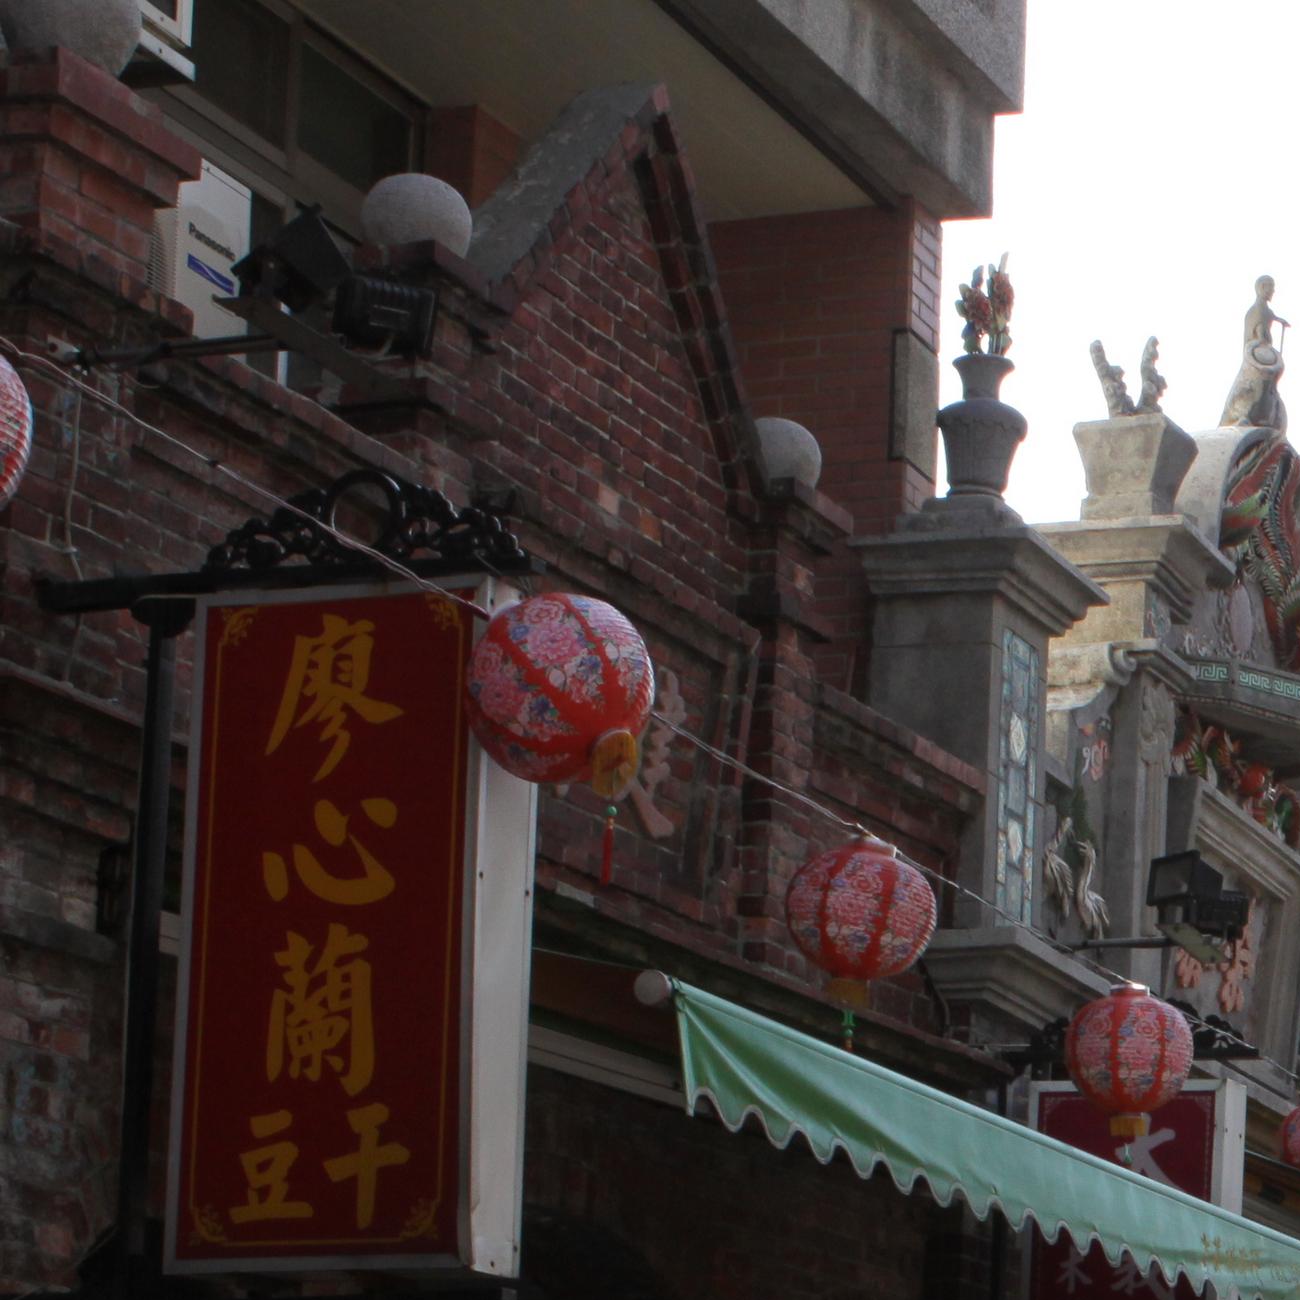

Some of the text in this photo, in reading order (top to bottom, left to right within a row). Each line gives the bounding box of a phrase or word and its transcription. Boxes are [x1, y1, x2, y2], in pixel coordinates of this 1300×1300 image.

[187, 221, 236, 263] Panasonic
[263, 611, 406, 1098] 廖心蘭
[230, 1099, 411, 1233] 豆干
